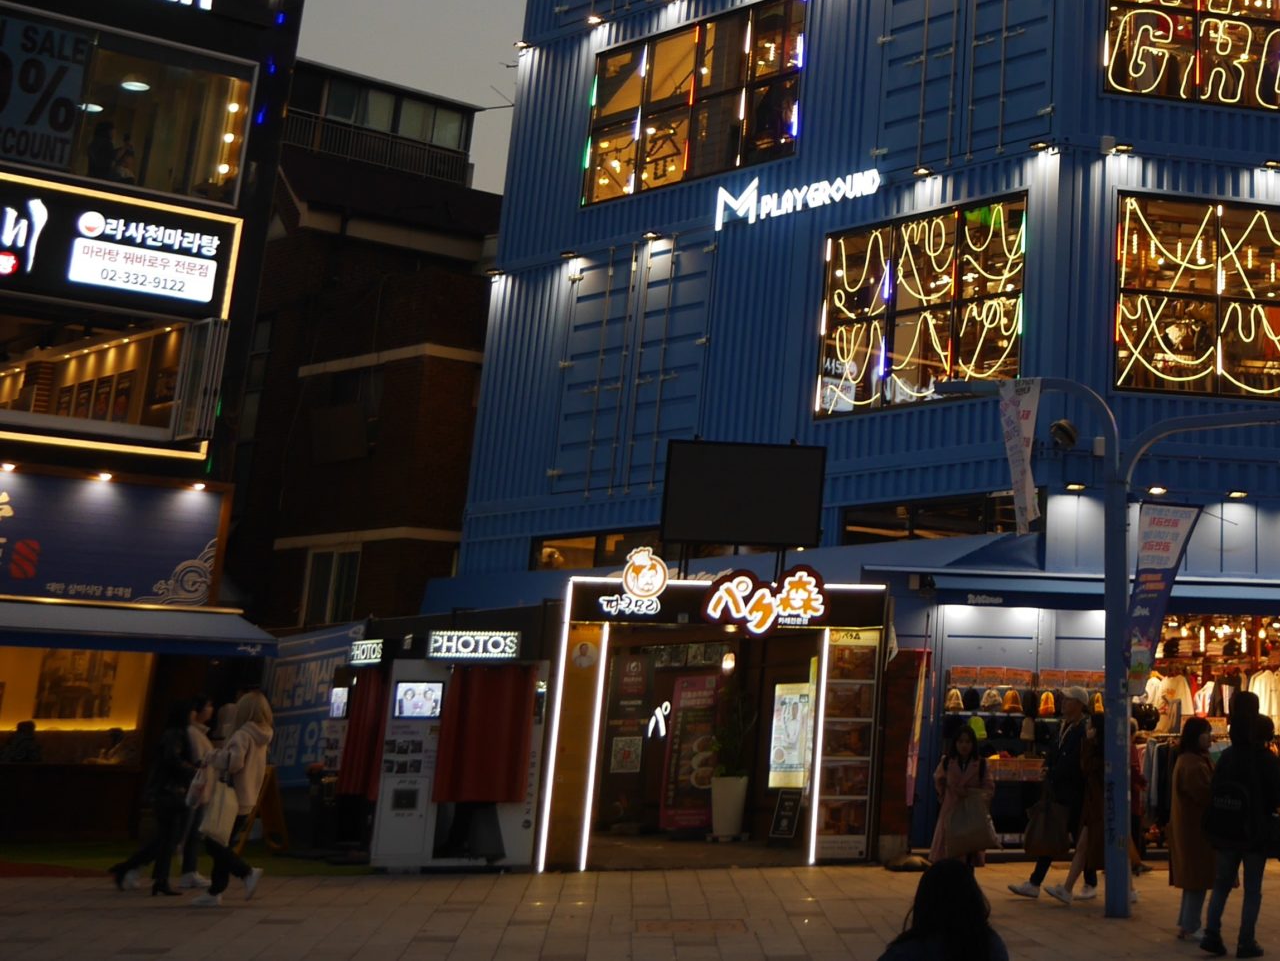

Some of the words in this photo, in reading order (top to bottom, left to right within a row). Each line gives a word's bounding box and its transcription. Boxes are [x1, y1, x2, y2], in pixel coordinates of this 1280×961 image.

[21, 26, 87, 65] SALE
[760, 168, 881, 219] PLAYGROUND
[82, 245, 121, 263] 마라탕
[123, 249, 171, 270] 꿔바로우
[174, 260, 209, 278] 전문점
[100, 268, 186, 292] 02-332-9122
[352, 643, 383, 659] PHOTOS
[432, 636, 518, 654] PHOTOS
